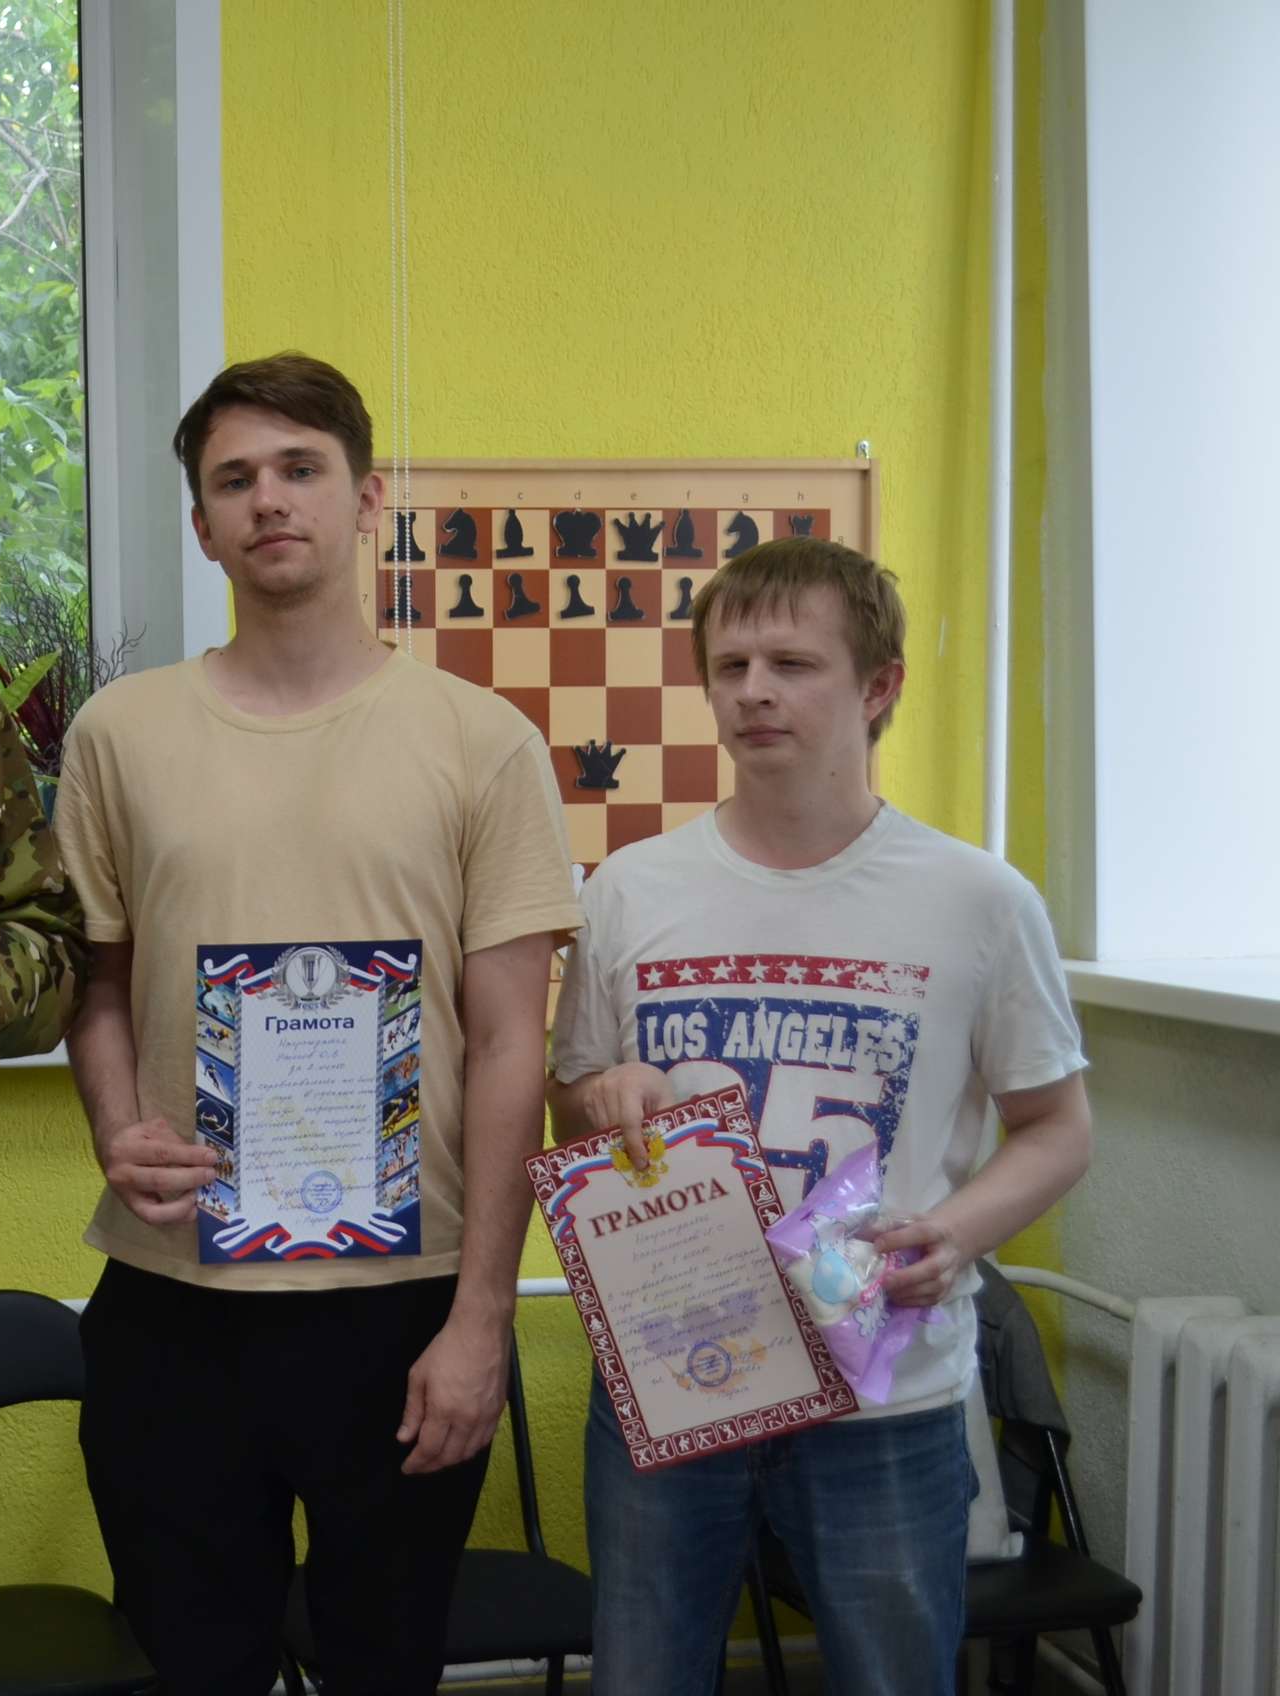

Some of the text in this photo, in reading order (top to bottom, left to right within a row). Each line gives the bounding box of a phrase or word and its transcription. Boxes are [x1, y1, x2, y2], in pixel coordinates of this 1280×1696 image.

[460, 488, 469, 500] b
[574, 489, 581, 500] d
[360, 535, 369, 545] 8
[265, 1015, 355, 1034] Грамота
[646, 1010, 904, 1073] LOS ANGELES
[588, 1177, 729, 1238] ГРАМОТА
